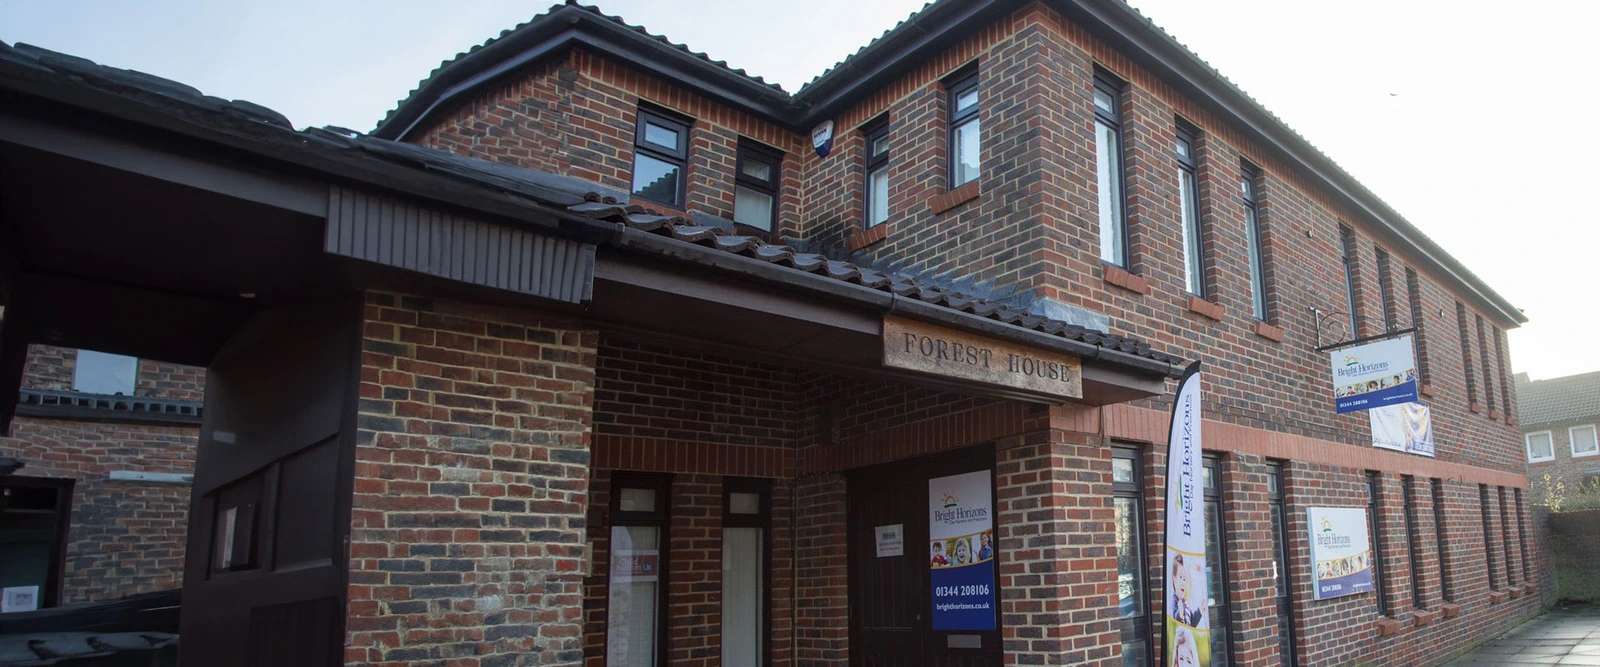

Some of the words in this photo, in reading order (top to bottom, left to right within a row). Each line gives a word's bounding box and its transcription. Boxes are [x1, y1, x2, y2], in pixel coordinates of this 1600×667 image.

[903, 332, 993, 369] FOREST
[1007, 353, 1071, 383] HOUSE
[1337, 364, 1357, 377] Bright
[1359, 360, 1390, 374] Horizons
[1182, 394, 1191, 476] Horizons
[935, 508, 955, 523] Bright
[956, 505, 988, 519] Horizons
[1183, 483, 1192, 537] Bright
[1317, 532, 1331, 545] Bright
[1332, 532, 1351, 544] Horizons
[935, 585, 959, 597] 01344
[960, 583, 990, 596] 208106
[936, 601, 990, 612] brighthorizons.co.uk
